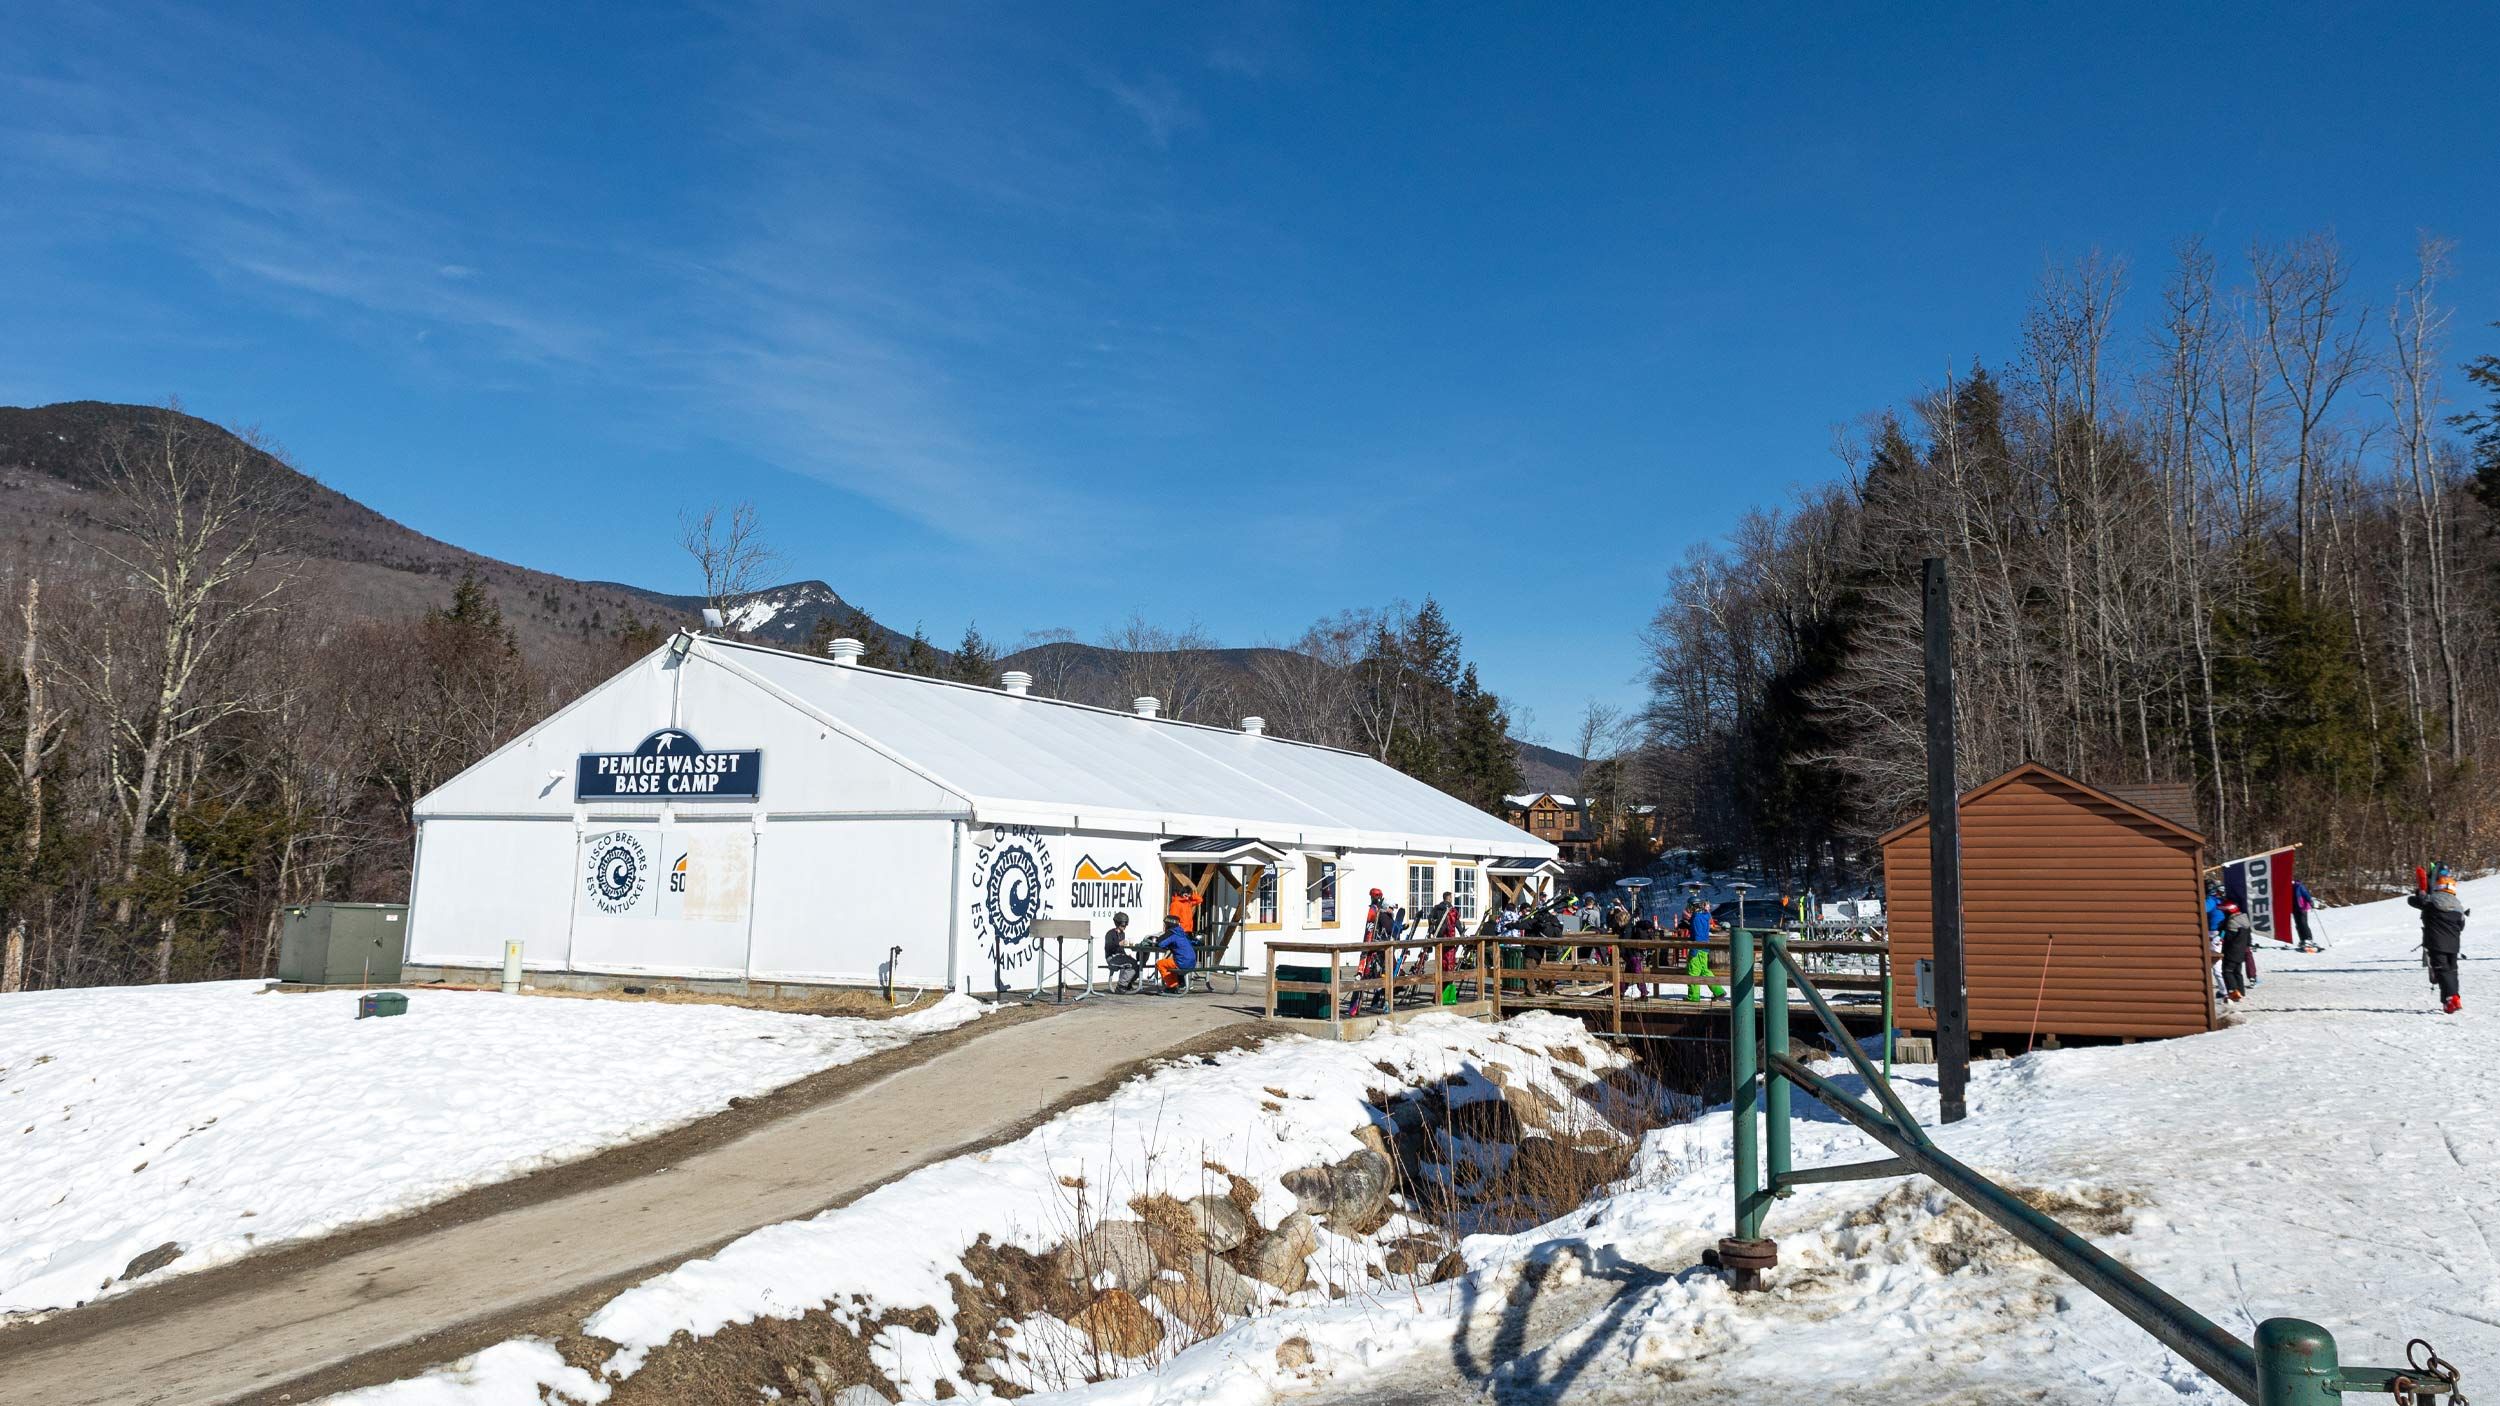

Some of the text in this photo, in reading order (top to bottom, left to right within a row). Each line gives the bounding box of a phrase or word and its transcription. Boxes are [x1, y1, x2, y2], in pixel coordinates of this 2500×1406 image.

[598, 754, 740, 775] PEMIGEWASSET
[615, 774, 719, 793] BASE CAMP
[588, 832, 648, 871] CISCO BREWERS
[1012, 823, 1055, 890] BREWERS
[597, 877, 646, 914] NANTUCKET
[2249, 859, 2272, 932] OPEN
